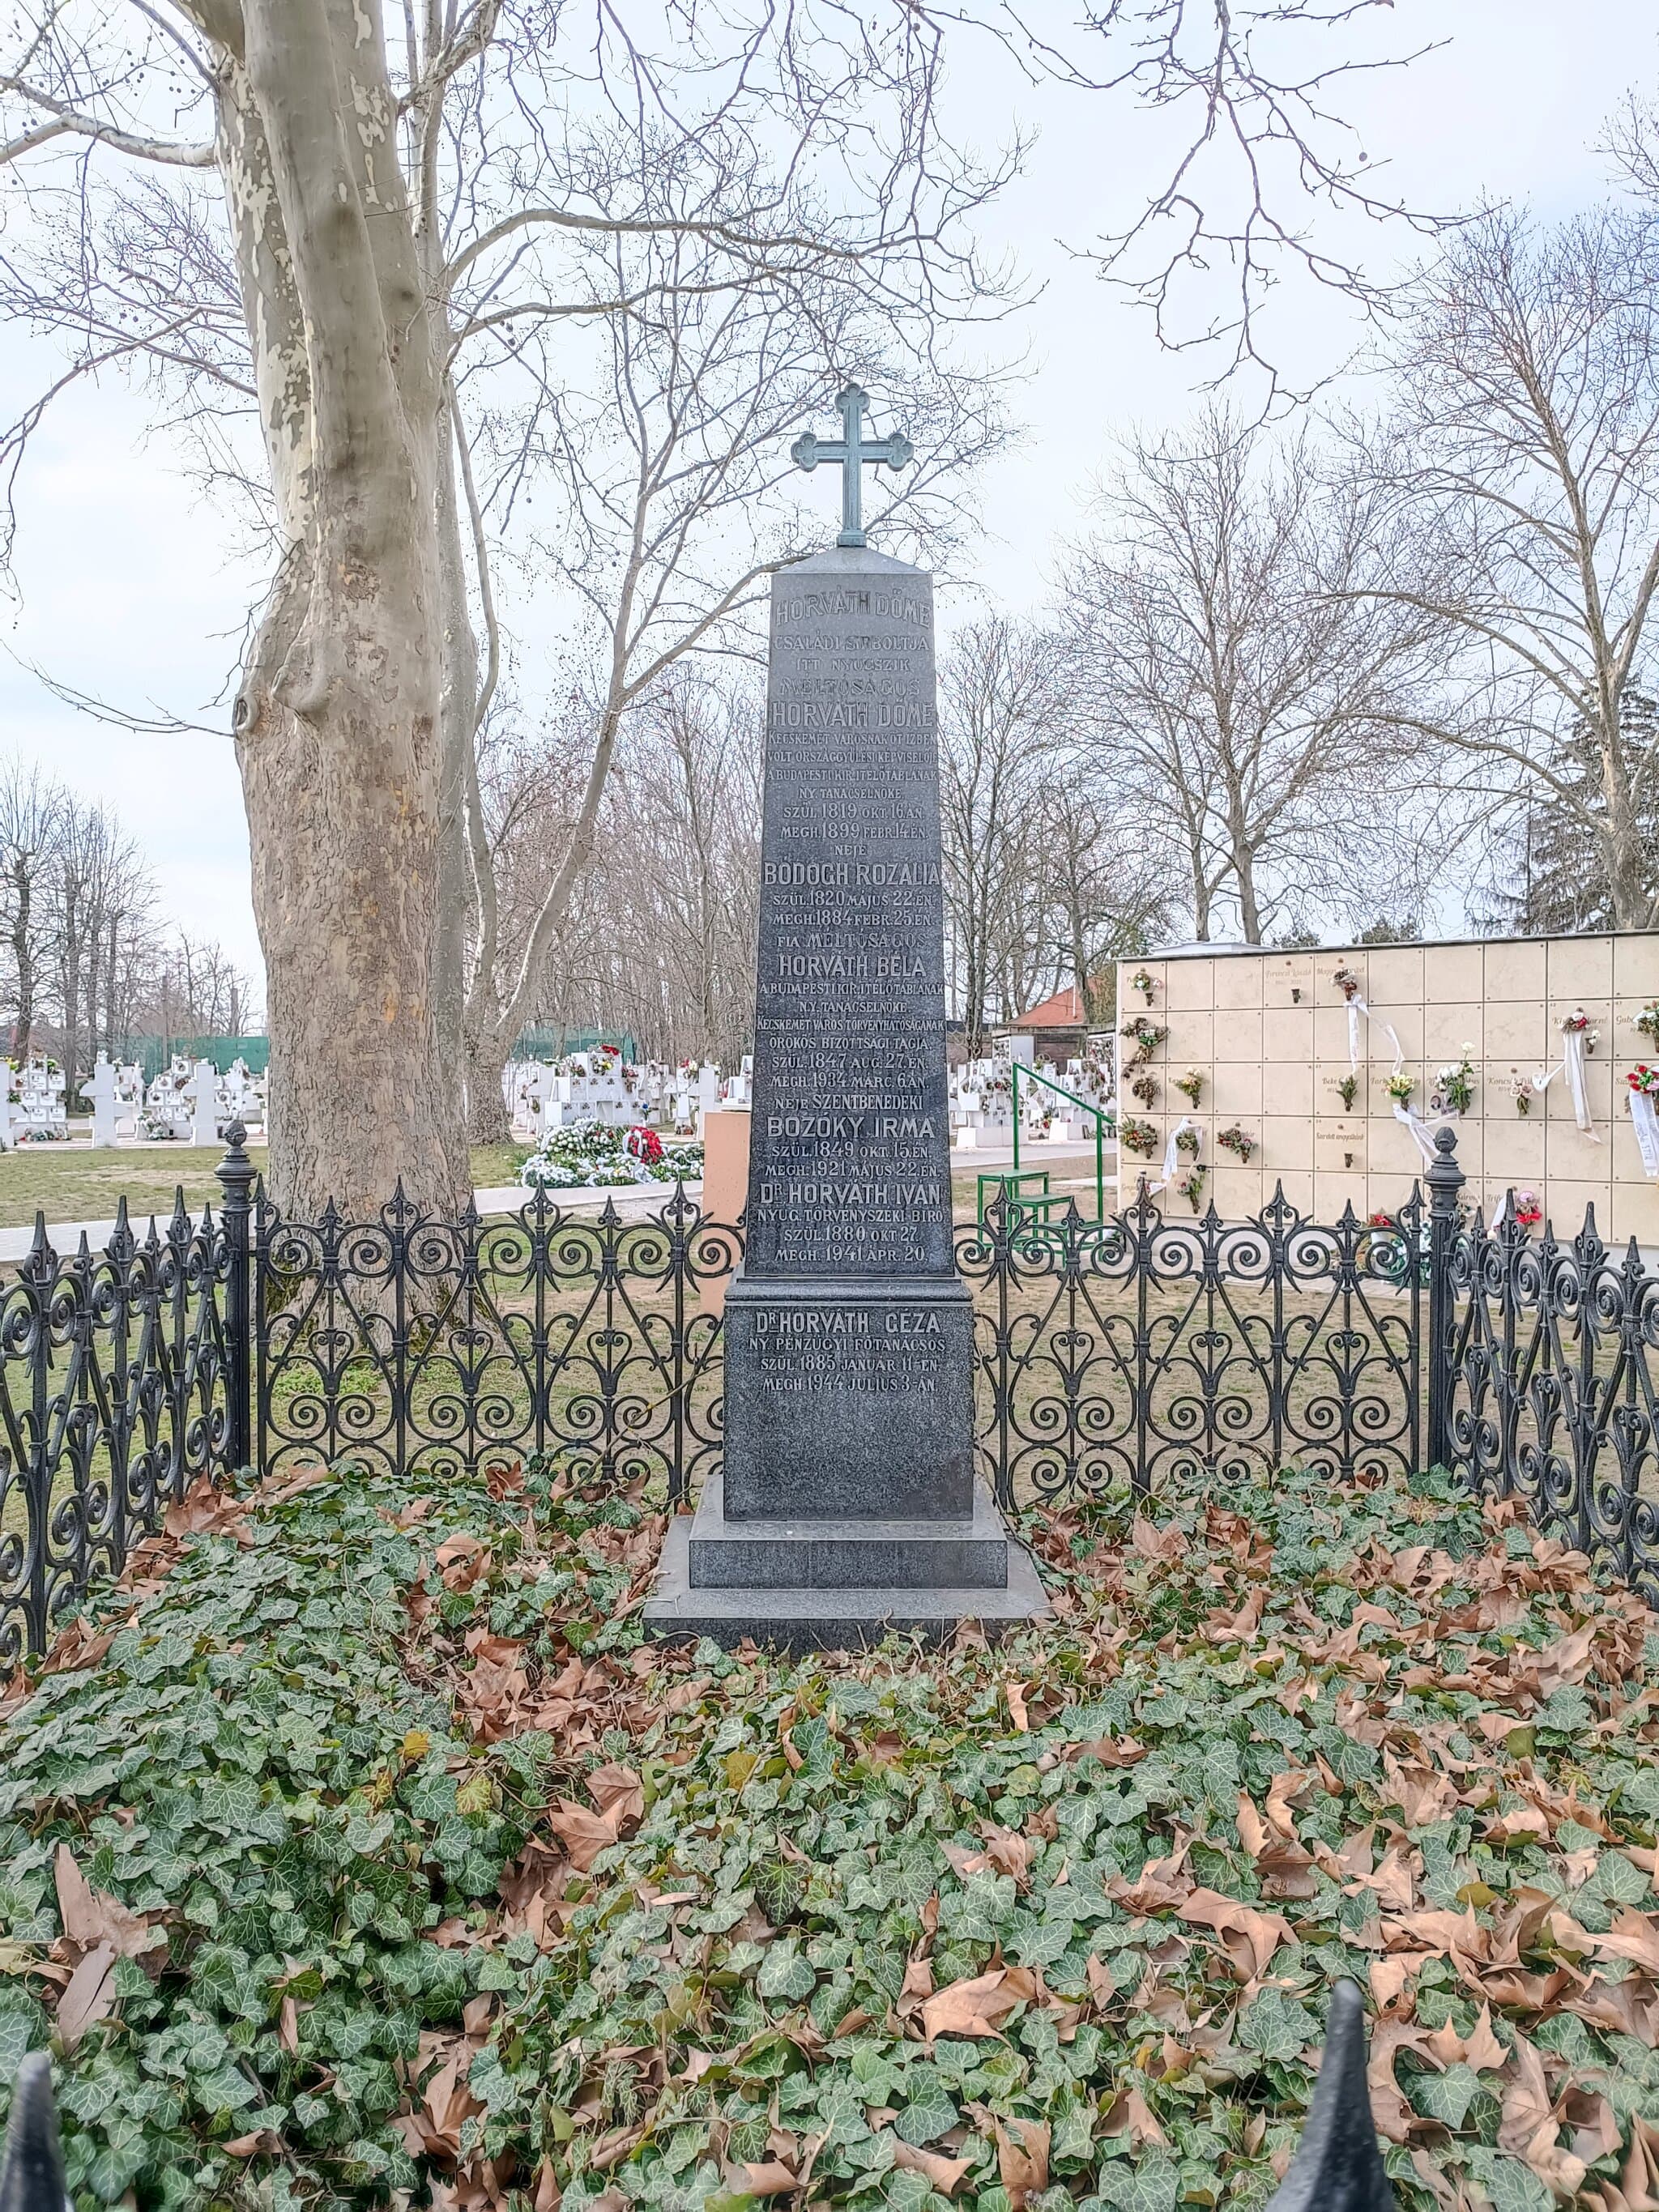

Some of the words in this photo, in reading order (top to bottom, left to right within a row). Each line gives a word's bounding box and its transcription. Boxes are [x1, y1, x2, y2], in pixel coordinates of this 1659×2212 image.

[776, 585, 871, 627] HORVÁTH
[774, 629, 840, 650] CSALÁDI
[796, 658, 820, 671] ITT
[831, 658, 911, 671] NYUGSZIK
[780, 673, 920, 697] MÉLTÓSÁGOS
[767, 751, 792, 762] VOLT
[766, 769, 774, 780] A
[821, 803, 857, 819] 1819
[822, 822, 859, 838] 1899
[834, 845, 867, 859] NEJE
[856, 857, 940, 885] ROZÁLIA
[810, 890, 845, 906] 1820
[847, 889, 889, 910] MÁJUS
[816, 910, 851, 925] 1884
[777, 936, 801, 948] FIA
[807, 928, 928, 948] MÉLTÓSÁGOS
[778, 952, 868, 976] HORVÁTH
[877, 951, 927, 977] BÉLA
[760, 982, 768, 995] A
[812, 1014, 842, 1030] VÁROS
[773, 1054, 807, 1068] SZÜL.
[810, 1053, 847, 1068] 1847
[770, 1076, 810, 1088] MEGH.
[812, 1072, 847, 1088] 1934
[775, 1098, 808, 1110] NEJE
[812, 1094, 923, 1110] SZENTBENEDEKI
[767, 1113, 864, 1137] BOZÓKY
[874, 1116, 935, 1138] IRMA
[772, 1142, 812, 1157] SZÜL.
[813, 1141, 854, 1157] 1849
[765, 1165, 809, 1176] MEGH.
[812, 1161, 846, 1176] 1921
[851, 1160, 892, 1179] MÁJUS
[788, 1178, 888, 1204] HORVÁTH
[896, 1179, 940, 1204] IVÁN
[757, 1209, 802, 1222] NYUG.
[804, 1205, 905, 1222] TÖRVÉNYSZÉKI
[784, 1226, 825, 1242] SZÜL.
[825, 1225, 865, 1242] 1880
[900, 1226, 919, 1242] 27.
[774, 1249, 821, 1261] MEGH.
[825, 1245, 862, 1261] 1941
[904, 1245, 928, 1261] 20.
[778, 1309, 868, 1333] HORVÁTH
[885, 1309, 940, 1333] GÉZA
[749, 1337, 770, 1350] NY.
[776, 1334, 847, 1350] PÉNZÜGYI
[761, 1355, 798, 1370] SZÜL.
[800, 1353, 836, 1370] 1885
[841, 1356, 897, 1370] JANUÁR
[762, 1378, 804, 1391] MEGH.
[808, 1374, 843, 1391] 1944
